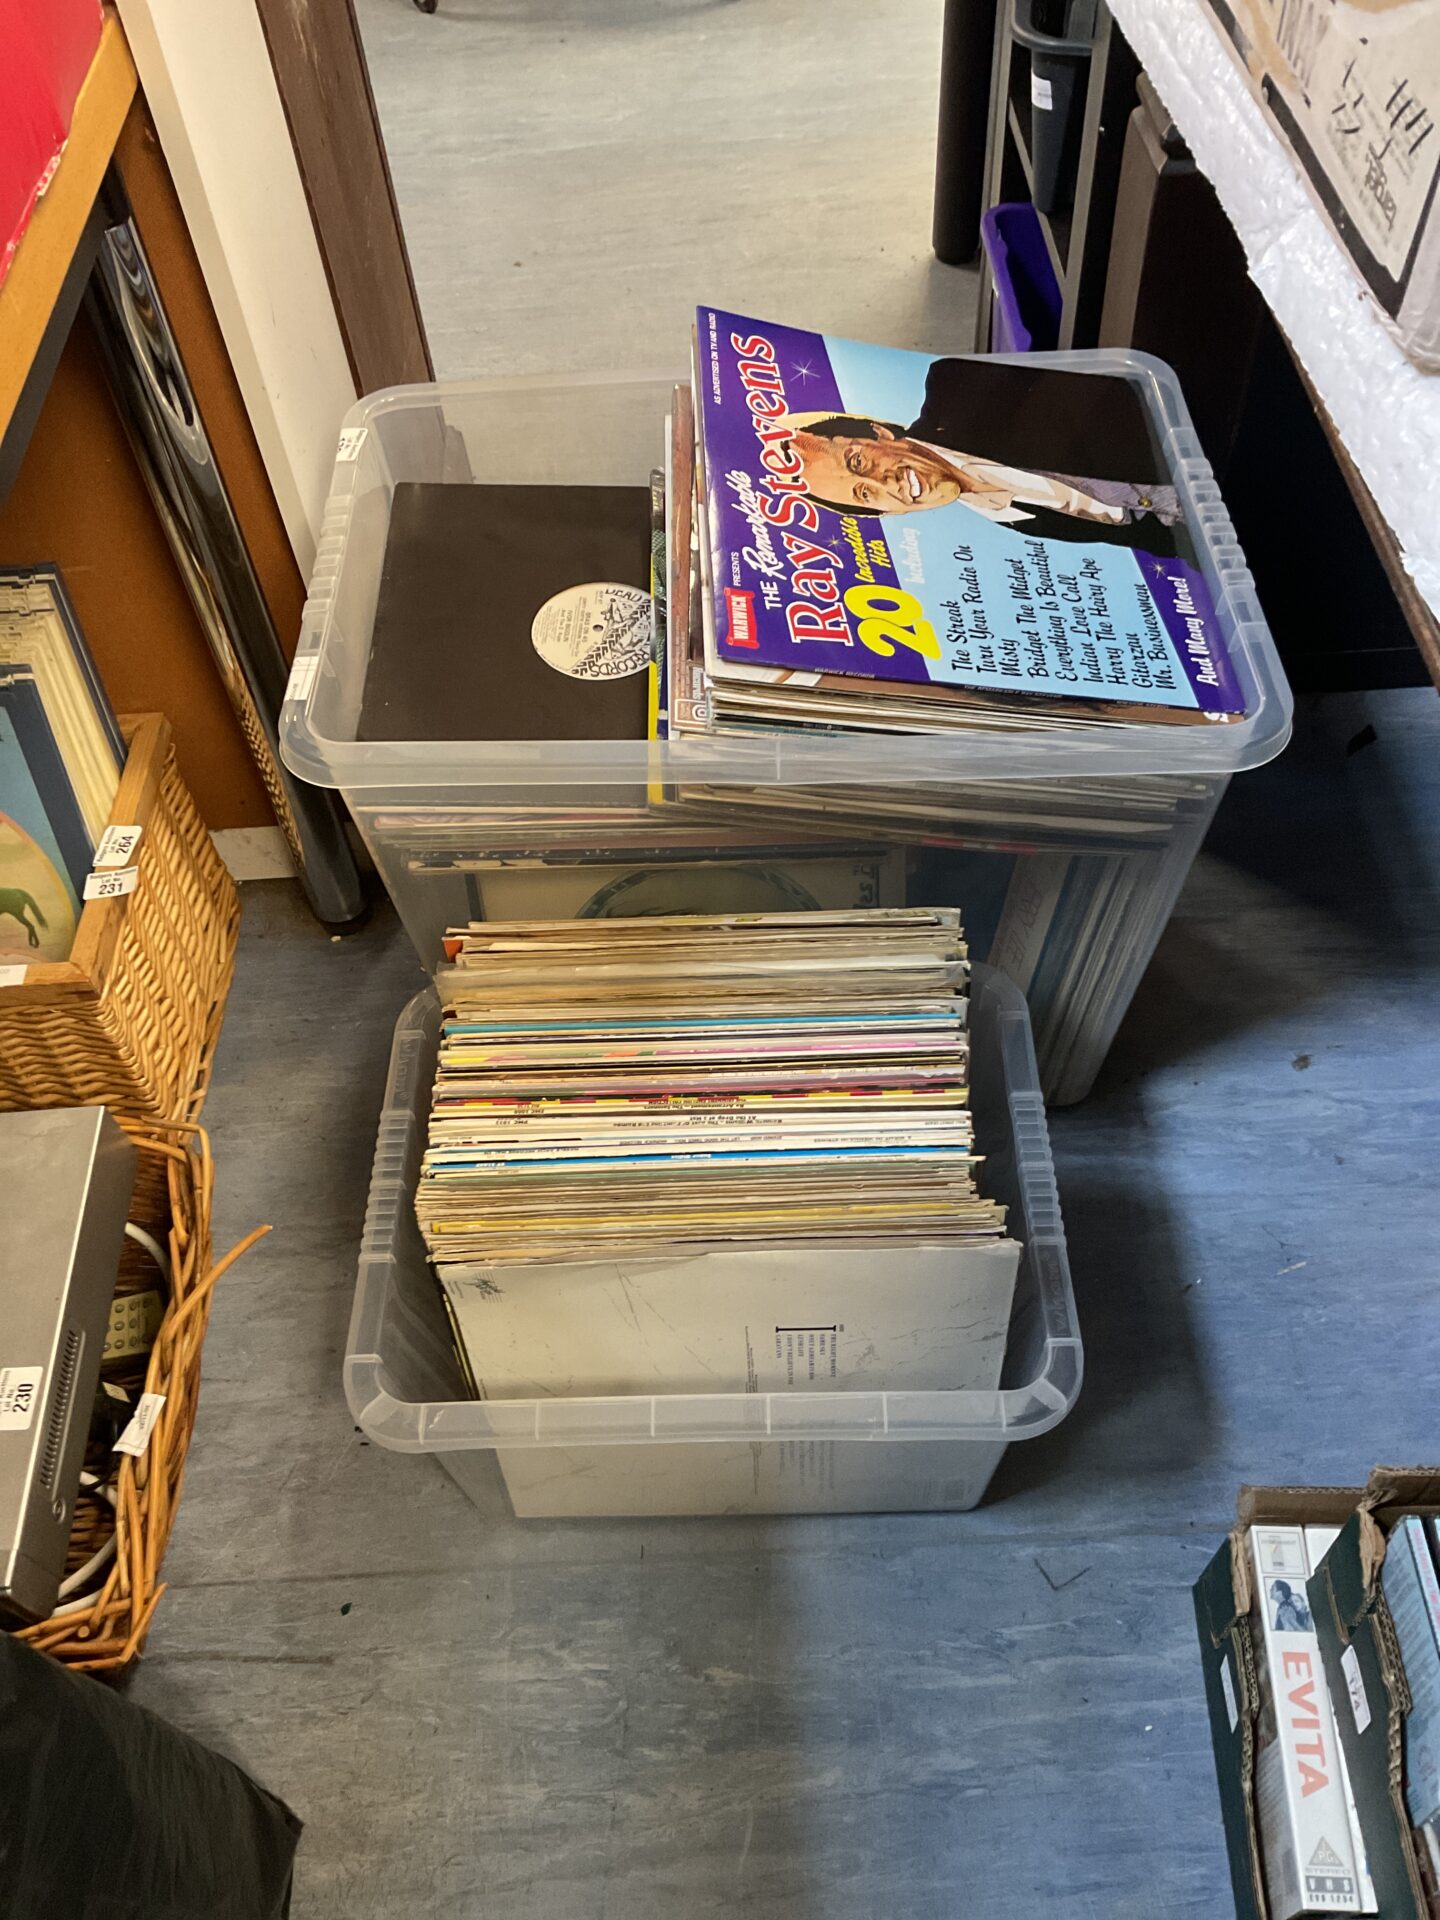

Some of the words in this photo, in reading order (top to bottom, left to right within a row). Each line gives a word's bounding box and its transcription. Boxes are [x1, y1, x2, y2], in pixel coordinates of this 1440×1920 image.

[708, 312, 716, 330] RADIO
[709, 330, 717, 342] AND
[710, 342, 718, 350] TV
[711, 351, 718, 360] ON
[711, 360, 721, 394] ADVERTISED
[714, 395, 721, 404] AS
[730, 332, 820, 533] Stevens
[724, 470, 787, 580] Remarkable
[840, 516, 876, 582] Incredible
[868, 539, 892, 567] Hits
[902, 527, 925, 584] Including
[953, 544, 973, 561] On
[731, 552, 741, 586] PRESENTS
[1004, 558, 1032, 600] Midget
[1024, 540, 1057, 597] Beautiful
[1080, 558, 1102, 581] Ape
[764, 581, 783, 610] THE
[780, 531, 854, 646] Ray
[962, 567, 984, 603] Radio
[1059, 574, 1083, 603] Call
[1167, 576, 1197, 614] More!
[1015, 604, 1036, 624] The
[1044, 601, 1062, 612] Is
[1088, 584, 1114, 618] Hairy
[730, 594, 749, 641] WARWICK
[843, 584, 942, 660] 20
[940, 600, 969, 644] Streak
[970, 609, 993, 640] Your
[1070, 606, 1093, 637] Love
[1097, 622, 1119, 642] The
[1134, 583, 1171, 661] Businessman
[1047, 615, 1079, 682] Everything
[1182, 616, 1209, 655] Many
[590, 649, 649, 677] RECORDS
[952, 649, 973, 671] The
[975, 644, 999, 674] Turn
[998, 638, 1022, 677] Misty
[1023, 630, 1049, 678] Bridget
[1078, 642, 1104, 683] Indian
[1103, 646, 1129, 686] Harry
[1125, 632, 1154, 688] Gitarzan
[814, 667, 844, 676] WARWICK
[845, 671, 876, 679] RECORDS
[1153, 665, 1177, 690] Mr.
[1194, 657, 1219, 686] And
[115, 836, 135, 854] 264
[98, 882, 123, 895] 231
[11, 1383, 34, 1413] 230
[1281, 1649, 1331, 1799] EVITA
[1317, 1850, 1335, 1862] PG
[1309, 1878, 1350, 1892] VHS
